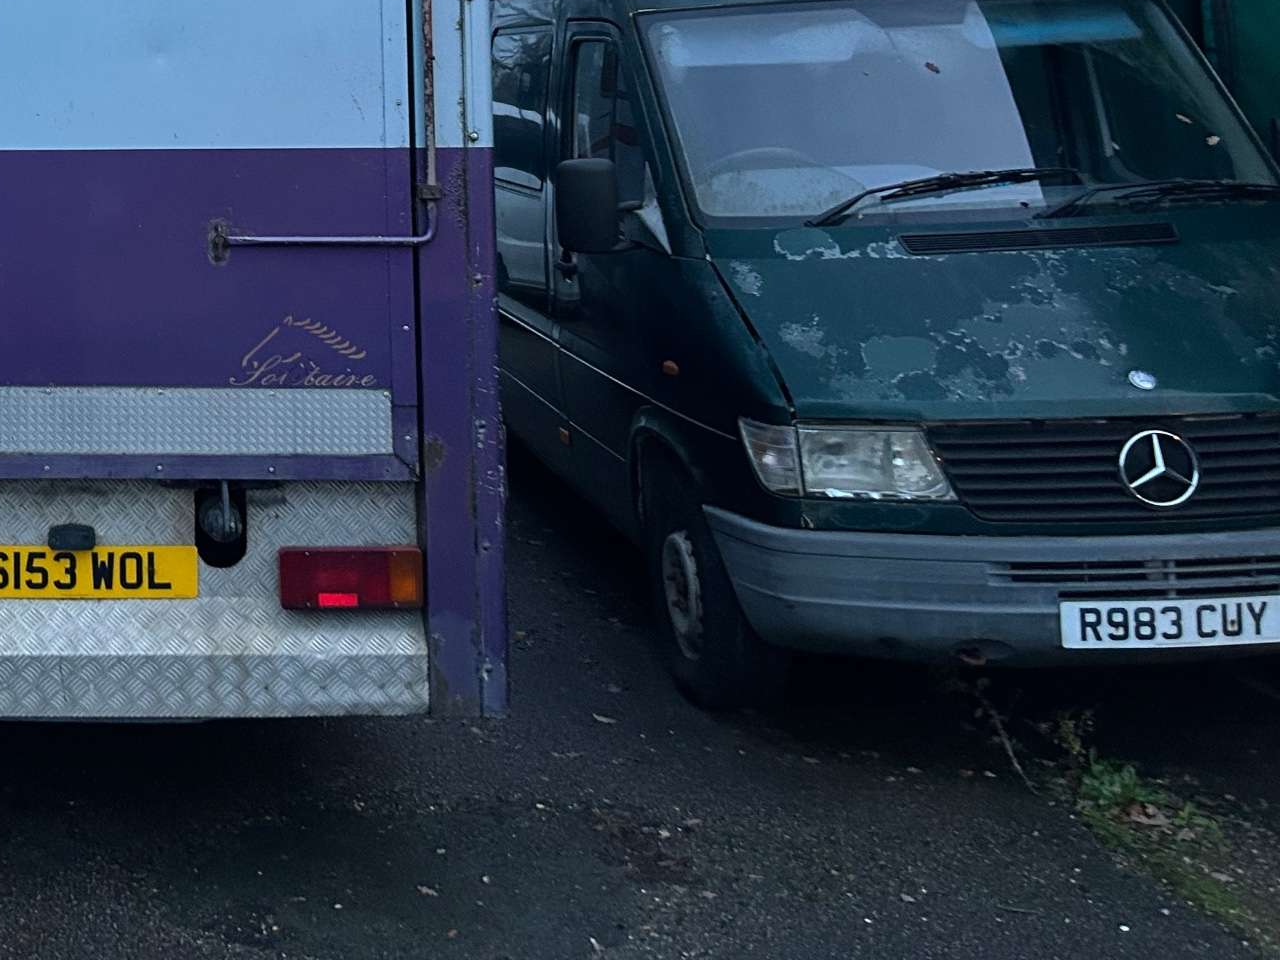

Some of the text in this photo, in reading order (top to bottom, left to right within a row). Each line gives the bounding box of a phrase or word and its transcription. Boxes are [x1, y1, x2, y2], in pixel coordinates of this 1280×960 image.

[228, 354, 377, 386] Sotaire
[91, 551, 172, 590] WOL
[1079, 601, 1268, 641] R983 CUY
